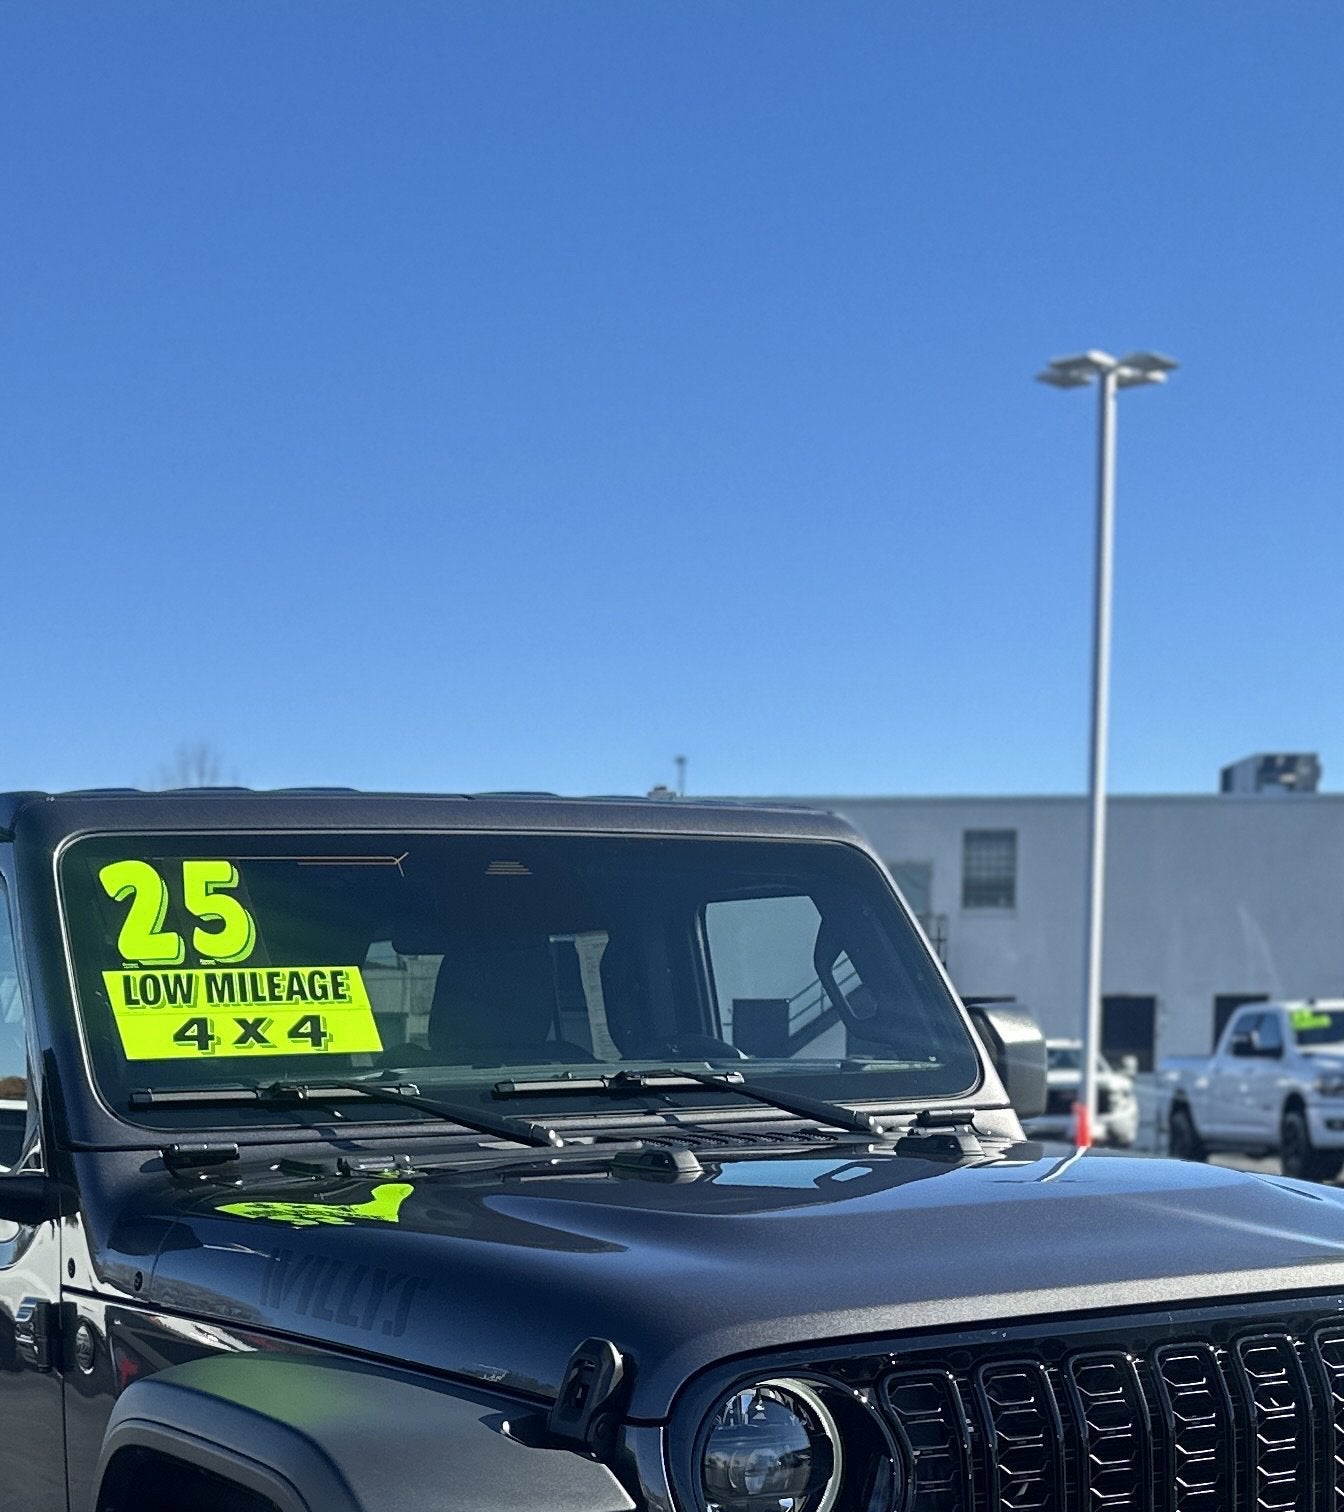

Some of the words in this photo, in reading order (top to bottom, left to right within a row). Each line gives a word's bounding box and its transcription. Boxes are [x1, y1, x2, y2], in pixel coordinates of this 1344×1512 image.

[98, 860, 256, 966] 25
[122, 973, 199, 1009] LOW
[206, 969, 353, 1008] MILEAGE
[259, 1248, 432, 1338] WILLYS
